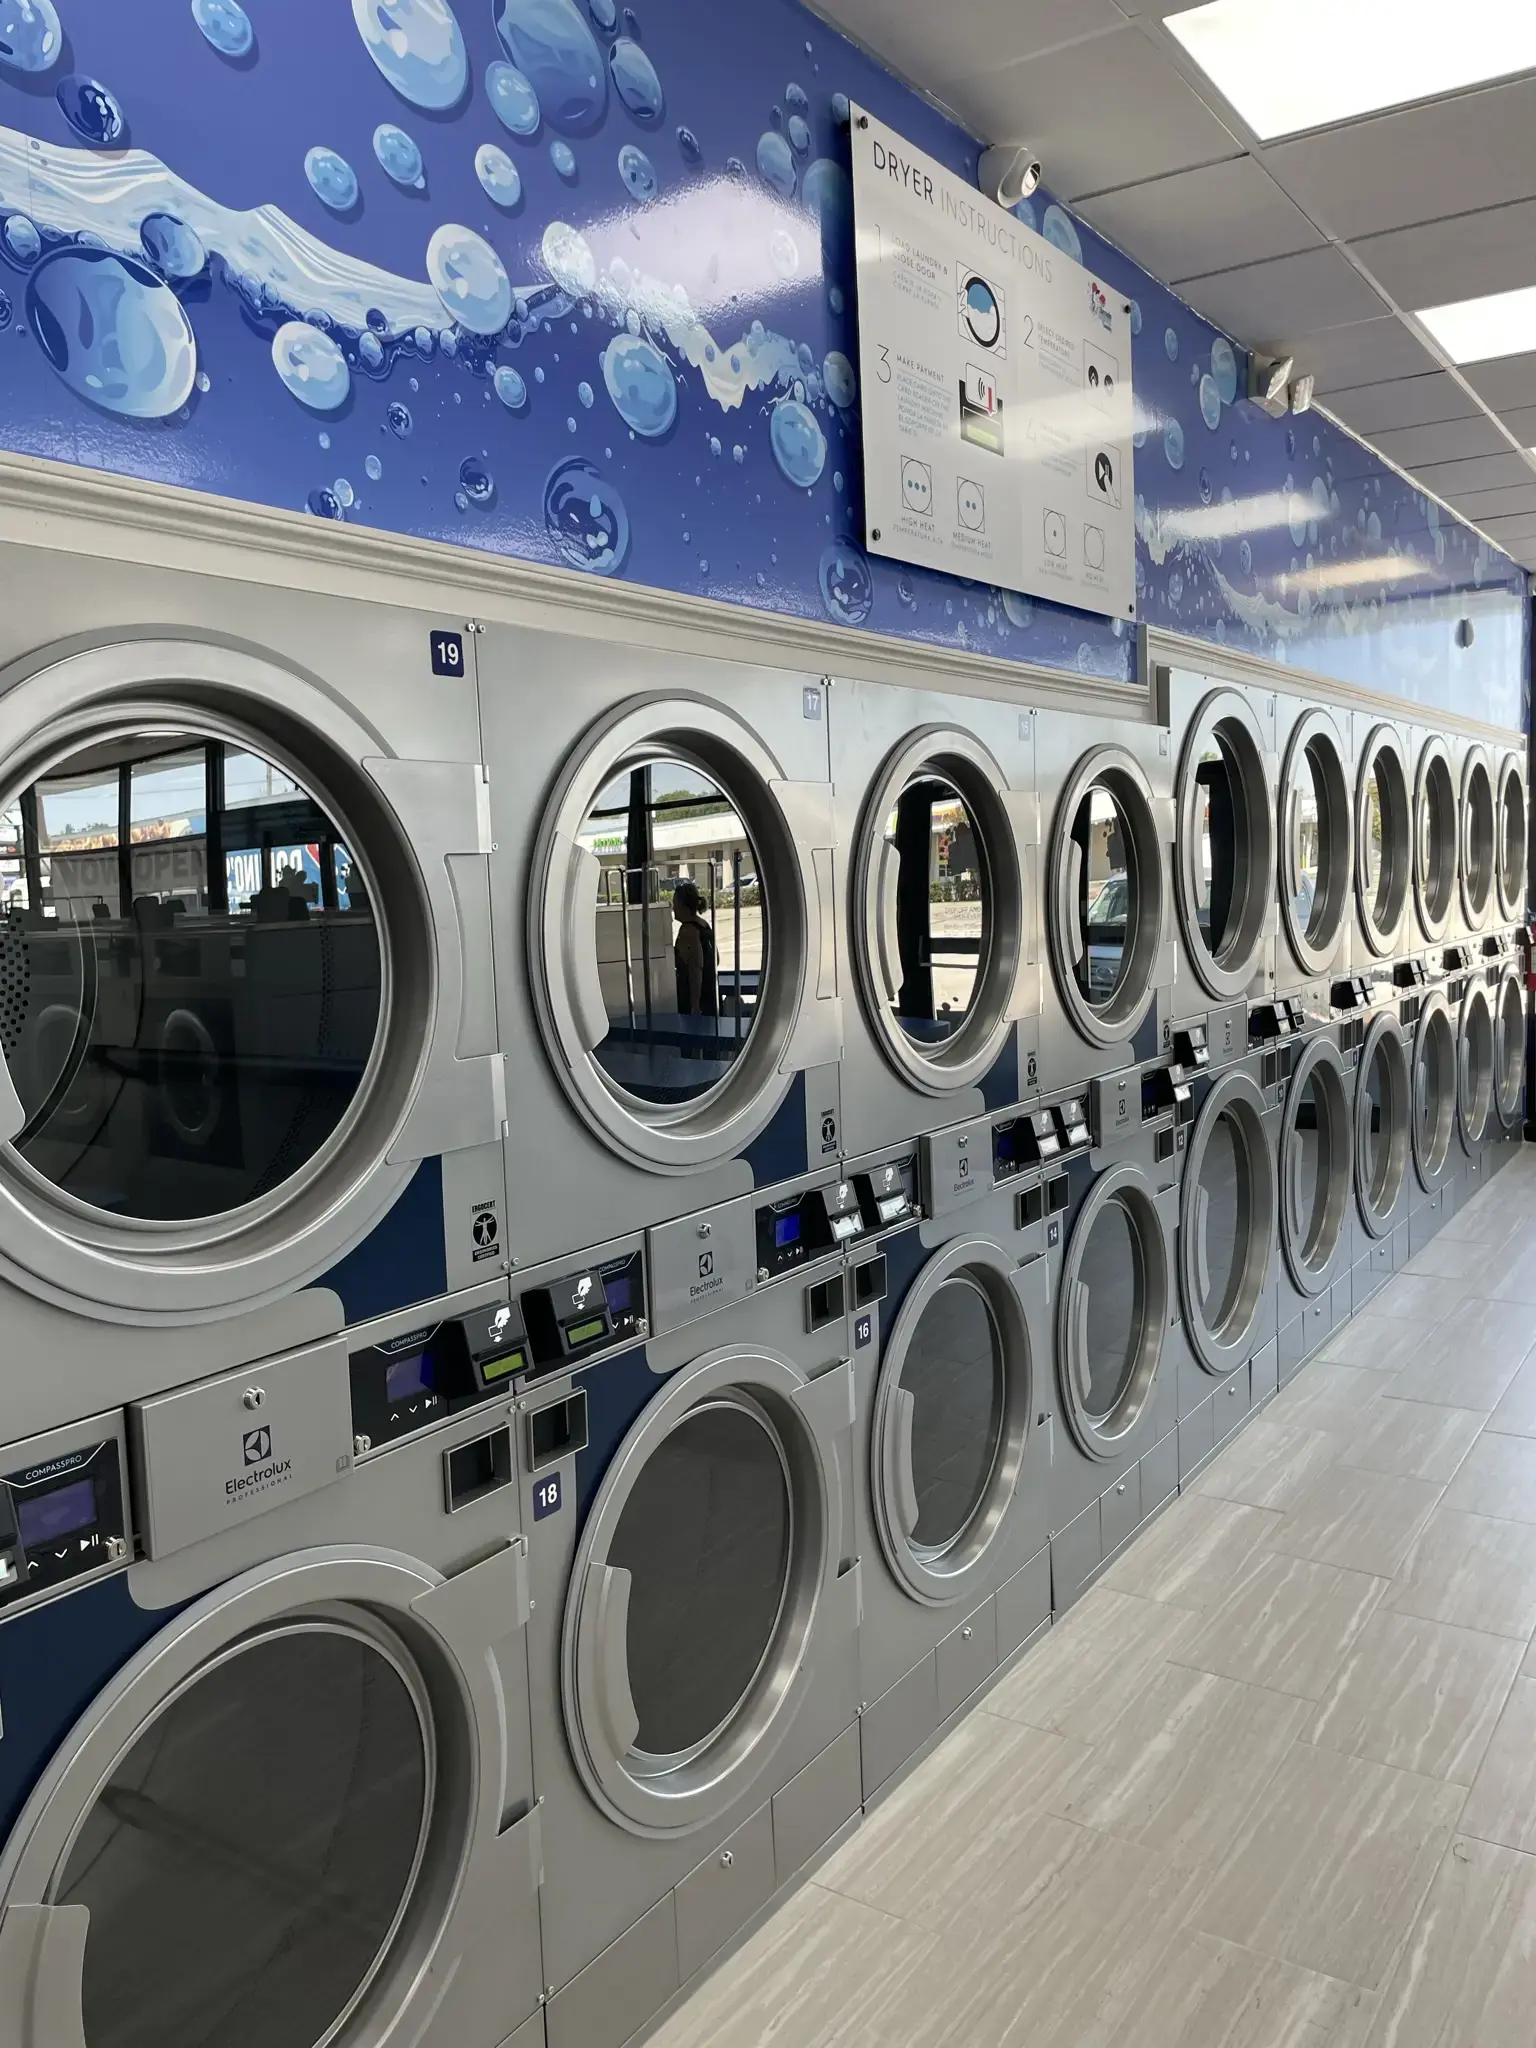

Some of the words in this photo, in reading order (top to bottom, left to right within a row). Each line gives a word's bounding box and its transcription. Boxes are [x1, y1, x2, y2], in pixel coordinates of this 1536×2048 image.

[873, 140, 934, 205] DRYER
[941, 187, 1053, 284] INSTRUCTIONS
[912, 247, 942, 272] LAUNDRY
[916, 262, 936, 280] DOOR
[1023, 314, 1035, 349] 2
[876, 343, 892, 384] 3
[896, 353, 915, 370] MAKE
[916, 362, 945, 384] PAYMENT
[919, 521, 935, 533] HEAT
[952, 531, 976, 546] MEDUM
[437, 641, 459, 666] 19
[806, 693, 819, 711] 17
[1049, 1226, 1058, 1241] 14
[690, 1276, 723, 1297] Electrolux
[390, 1330, 428, 1349] COMPASSPRO
[858, 1322, 870, 1340] 16
[25, 1454, 82, 1480] COMPASSPRO
[225, 1458, 292, 1495] Electrolux
[226, 1473, 293, 1505] PROFESSIONAL
[538, 1482, 558, 1508] 18
